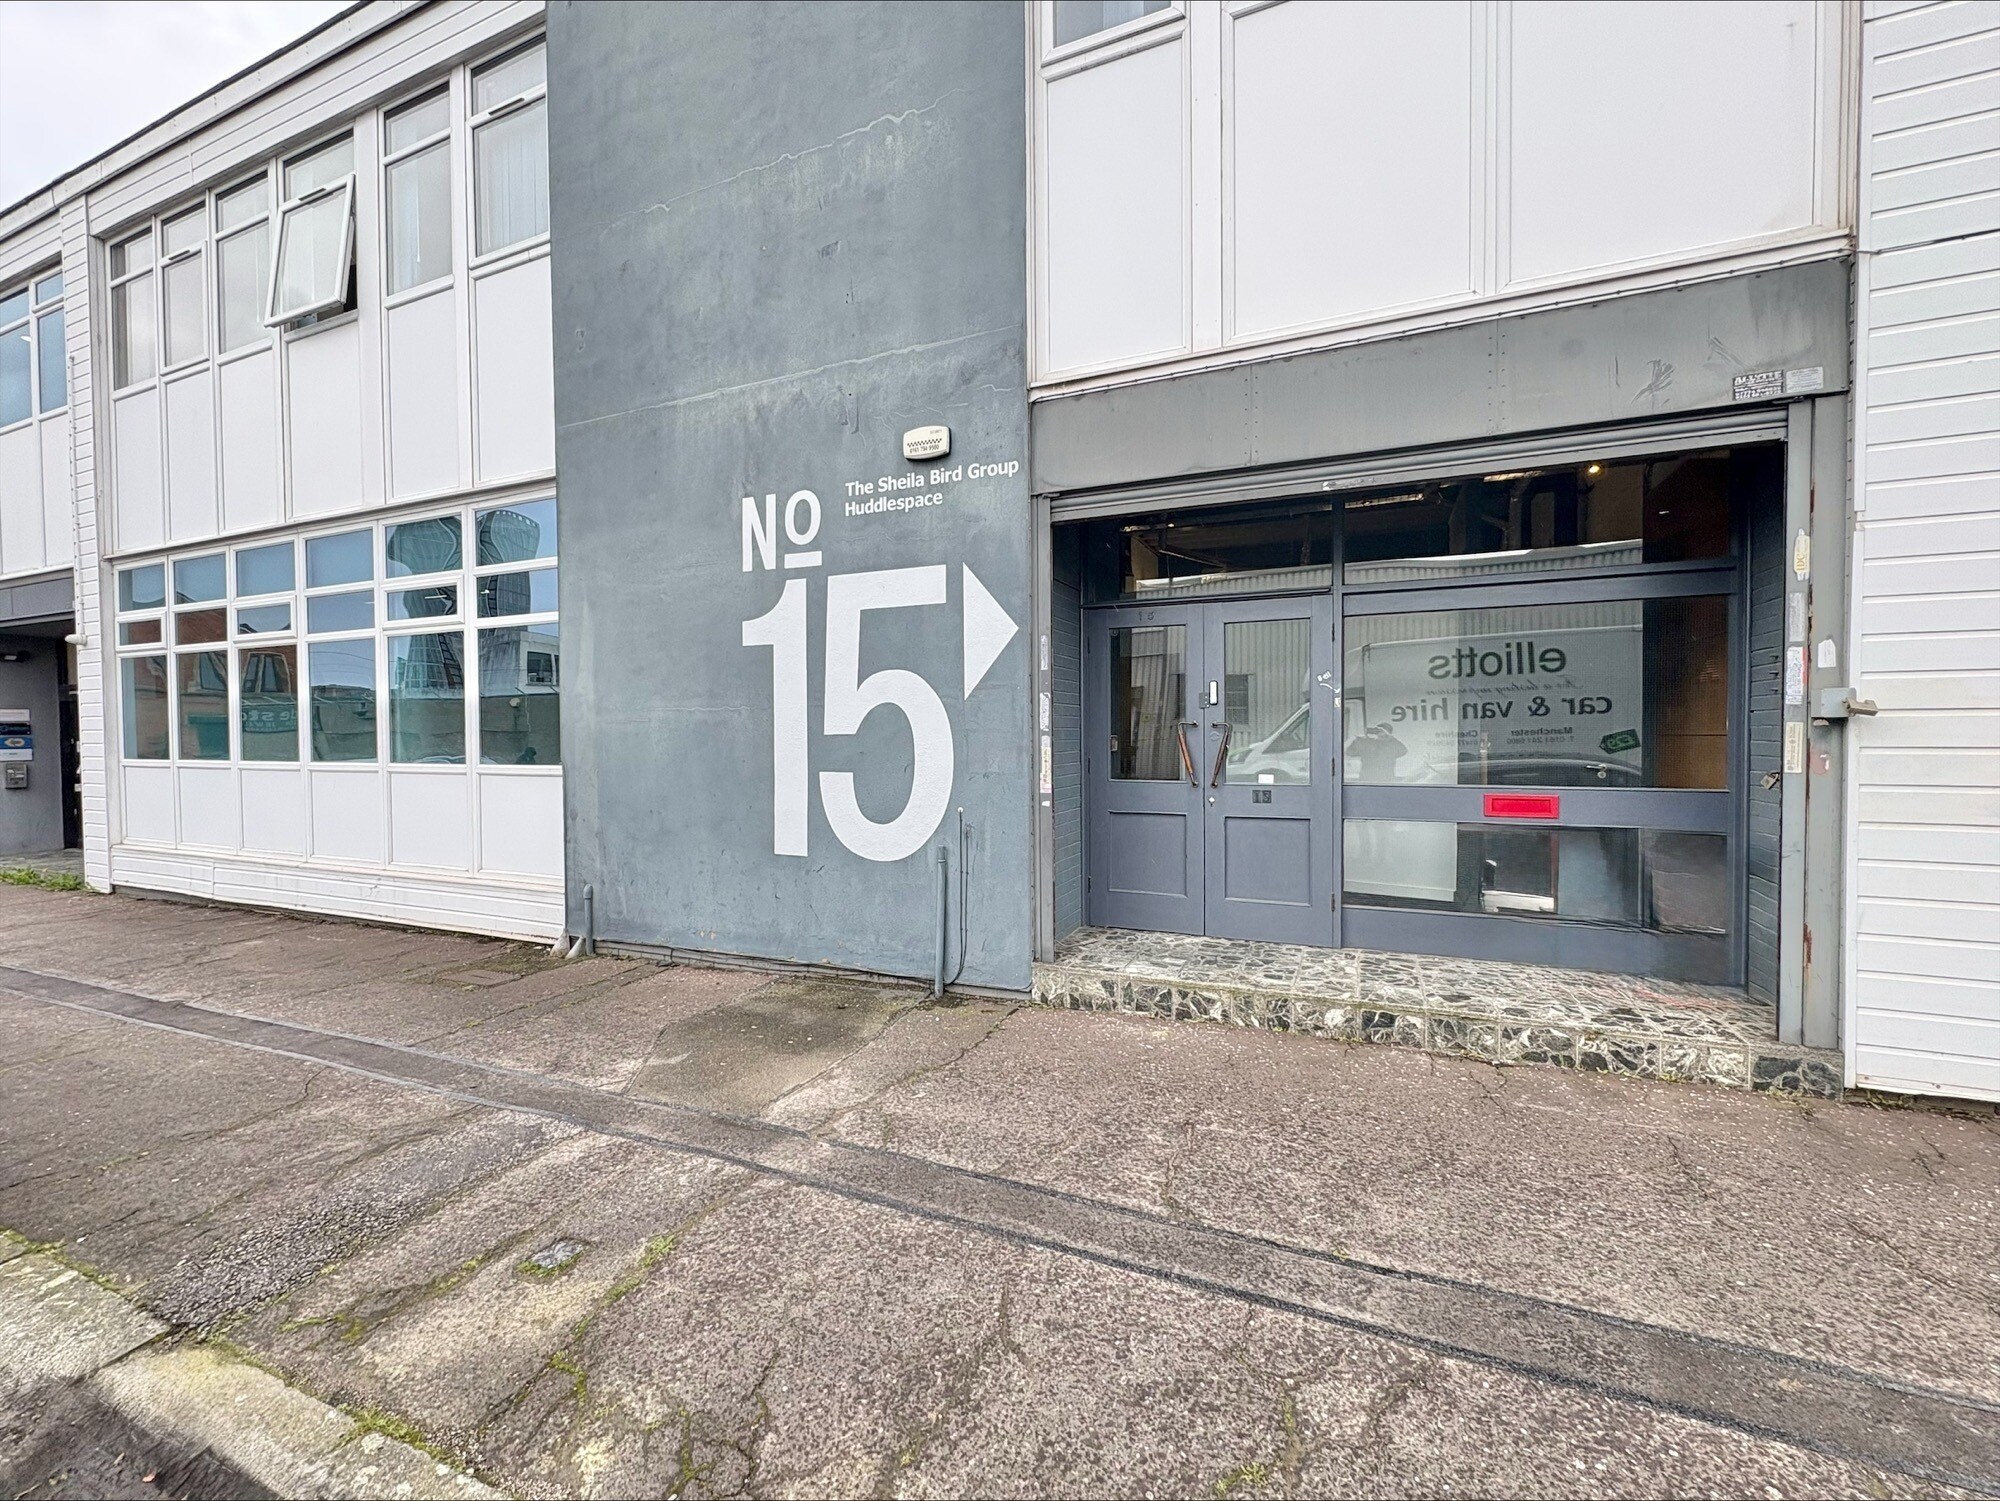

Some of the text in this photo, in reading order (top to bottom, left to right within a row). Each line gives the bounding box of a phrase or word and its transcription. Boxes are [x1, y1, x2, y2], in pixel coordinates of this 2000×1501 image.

[845, 459, 1019, 497] The Sheila Bird Group
[844, 492, 943, 517] Huddlespace
[741, 564, 955, 863] 15
